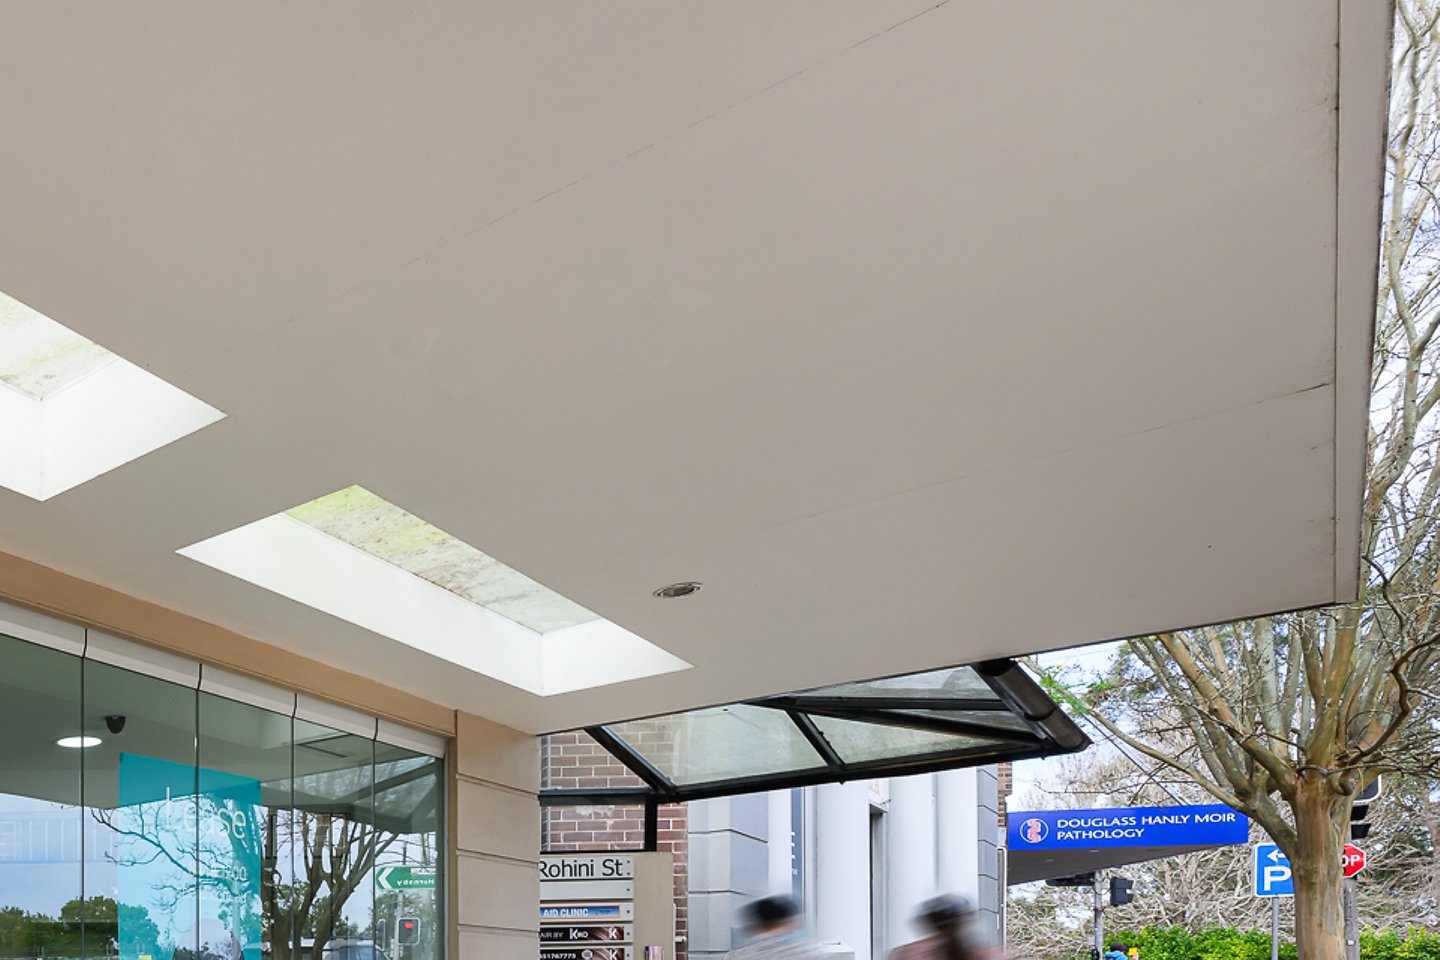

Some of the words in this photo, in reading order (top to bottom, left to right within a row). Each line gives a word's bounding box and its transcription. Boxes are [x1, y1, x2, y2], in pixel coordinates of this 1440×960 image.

[1057, 816, 1137, 829] DOUGLASS
[1141, 814, 1190, 825] HANLY
[1194, 812, 1236, 823] MOIR
[1057, 828, 1145, 840] PATHOLOGY
[539, 859, 594, 878] Rohini
[602, 858, 623, 877] St
[1263, 866, 1292, 891] P
[560, 908, 589, 917] CLINIC
